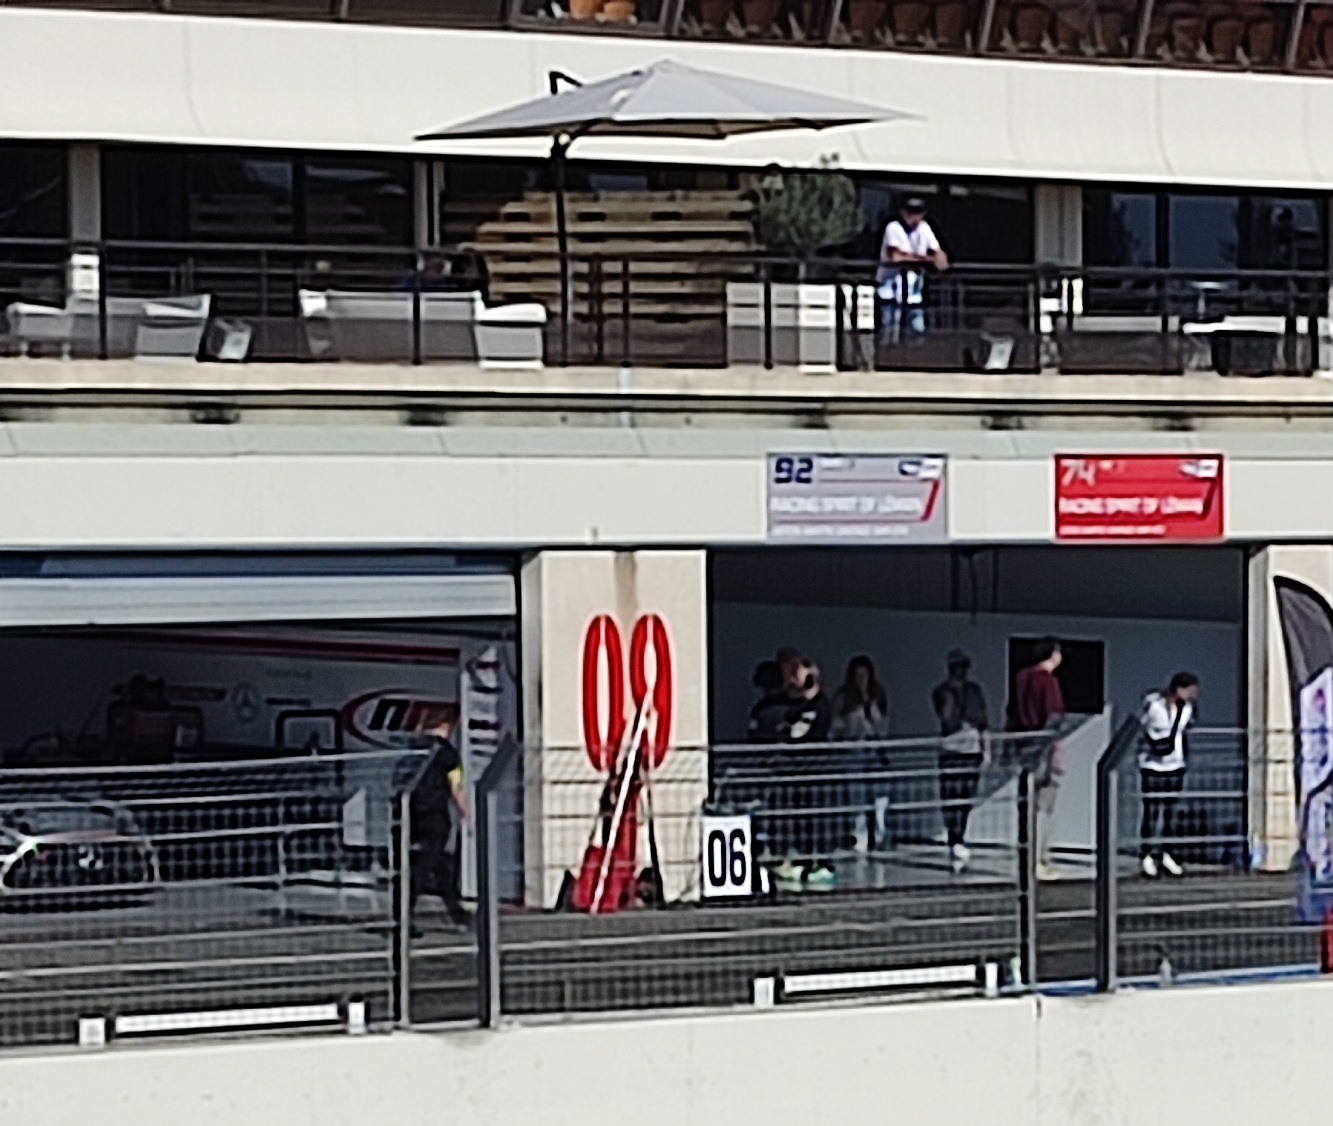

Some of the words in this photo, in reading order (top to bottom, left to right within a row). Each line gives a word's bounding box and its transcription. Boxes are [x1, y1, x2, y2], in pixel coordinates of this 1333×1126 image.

[774, 457, 814, 484] 92
[582, 614, 672, 771] 09
[707, 828, 746, 886] 06
